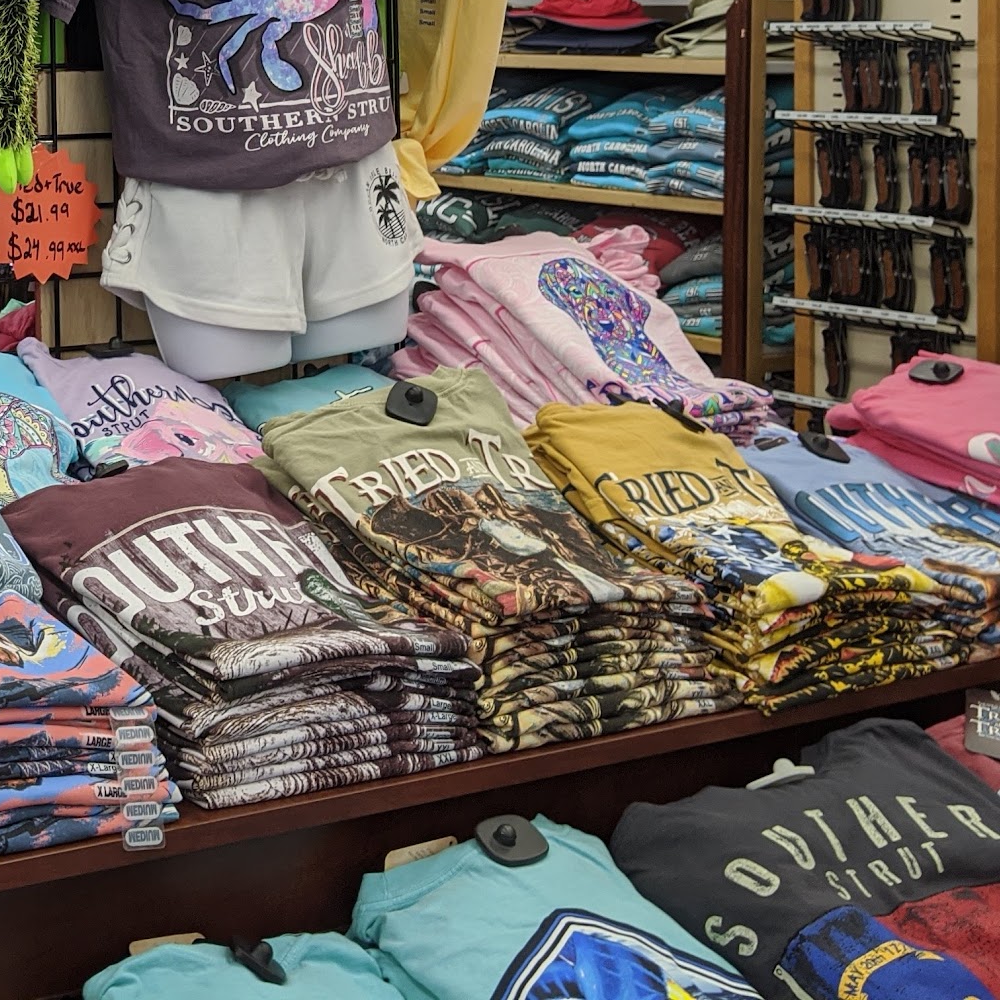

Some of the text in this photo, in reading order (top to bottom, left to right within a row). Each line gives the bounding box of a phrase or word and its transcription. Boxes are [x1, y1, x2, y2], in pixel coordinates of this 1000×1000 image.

[244, 122, 370, 152] Clothing Company
[577, 161, 606, 173] NORTH
[11, 197, 70, 225] $21.99
[7, 231, 65, 263] $24.99
[101, 409, 151, 437] STRUT
[310, 448, 462, 524] TRIED
[414, 642, 435, 652] Small
[432, 662, 452, 671] Small
[85, 706, 110, 716] LARGE
[432, 699, 452, 710] Large
[86, 735, 112, 748] LARGE
[437, 753, 455, 765] XXL
[825, 841, 945, 901] STRUT
[843, 965, 864, 997] MAY
